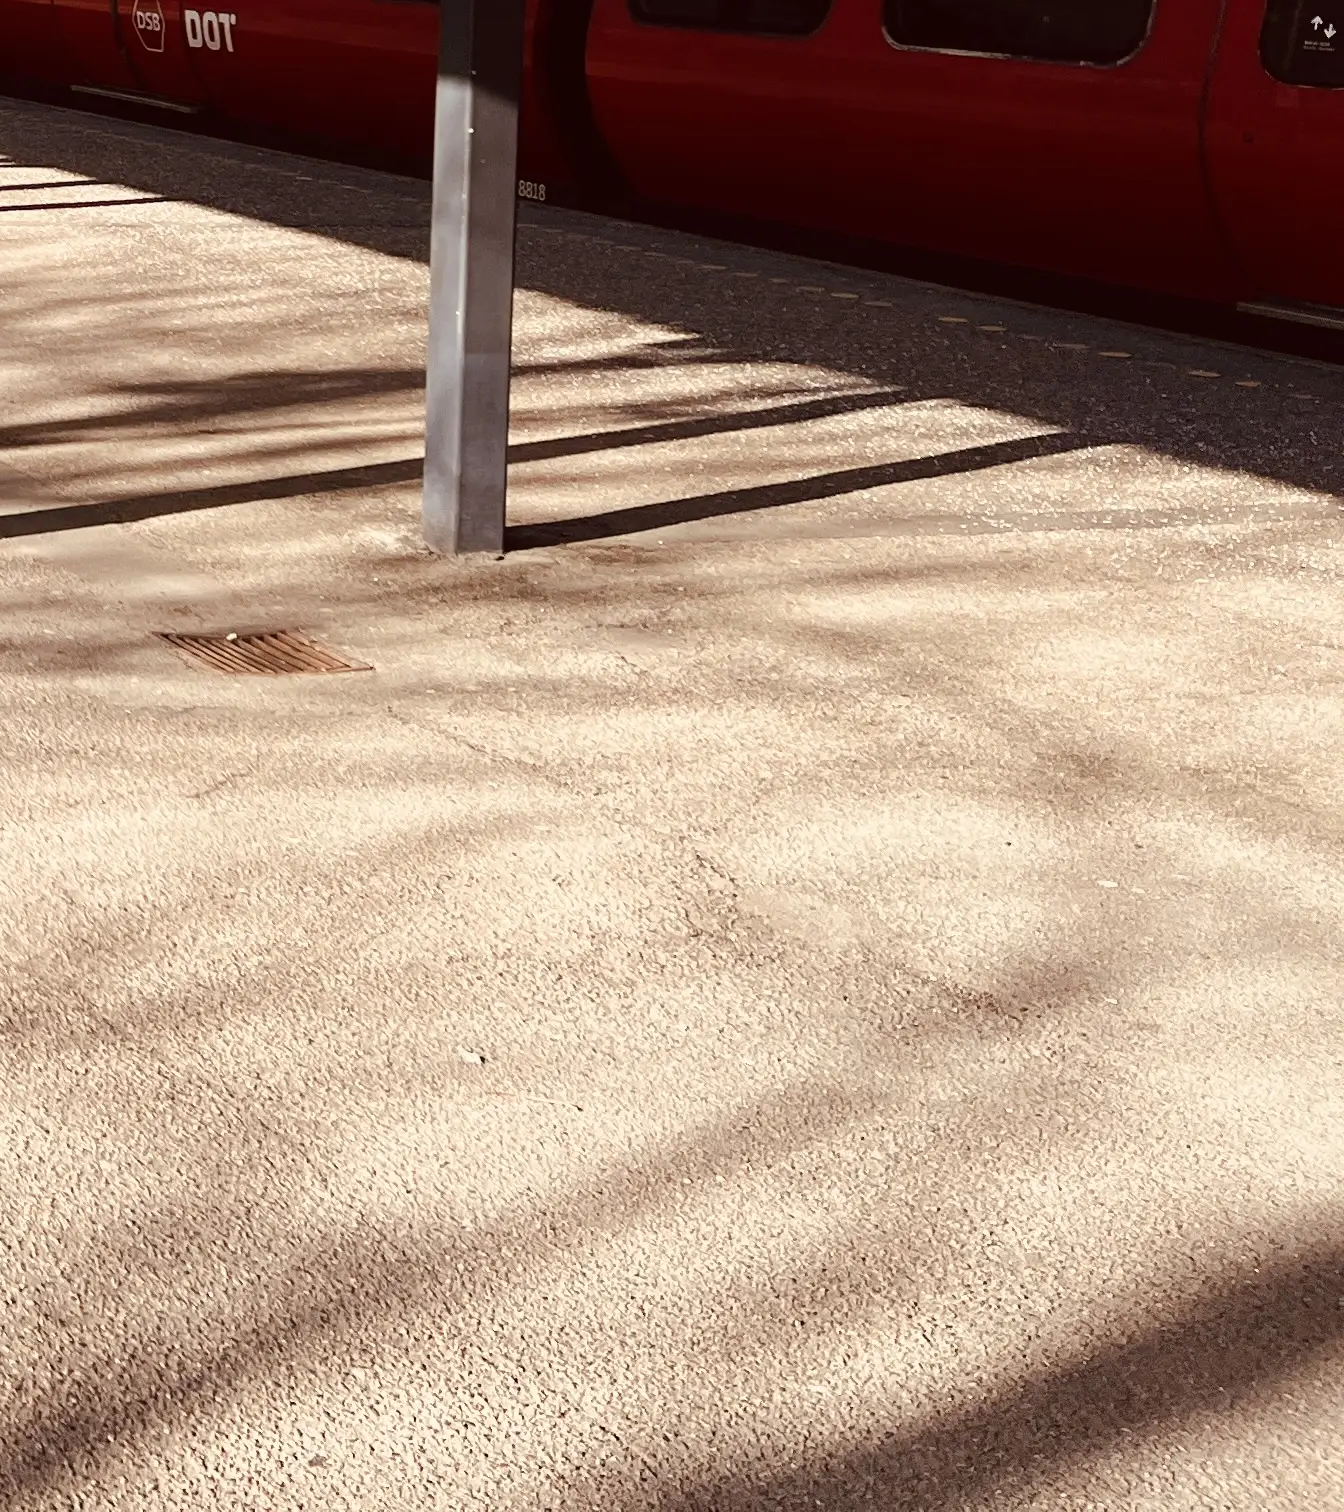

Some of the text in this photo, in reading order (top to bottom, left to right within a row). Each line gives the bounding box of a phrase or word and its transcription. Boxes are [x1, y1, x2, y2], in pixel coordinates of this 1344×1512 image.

[136, 11, 161, 32] DSB
[184, 9, 236, 53] DOT
[518, 179, 546, 201] 8818
